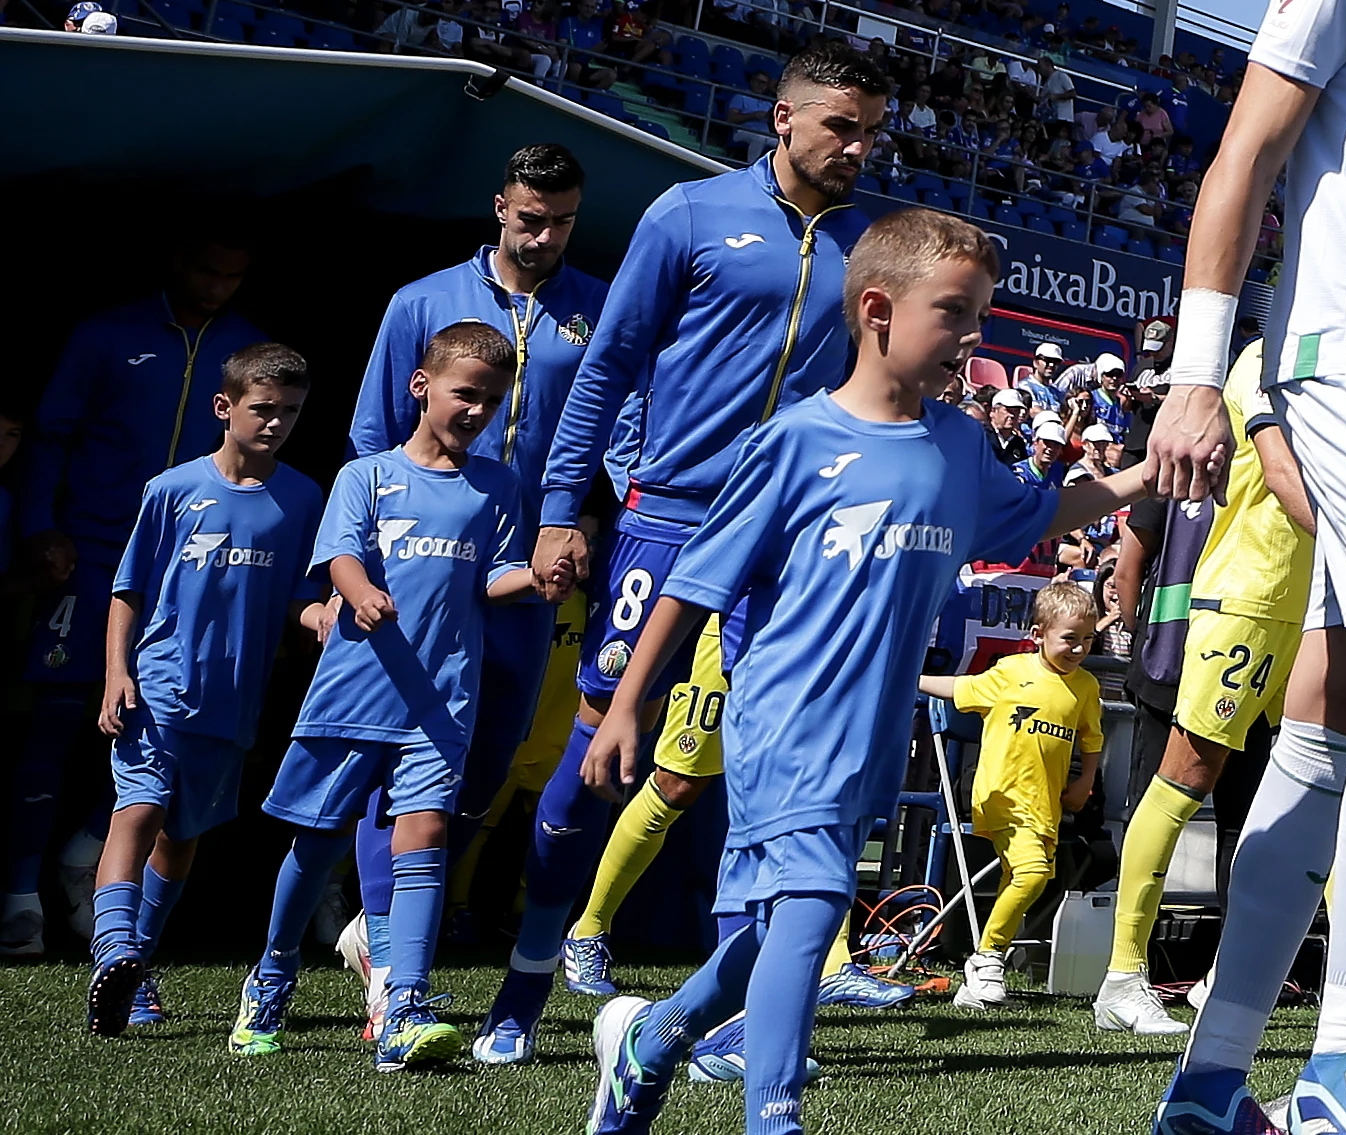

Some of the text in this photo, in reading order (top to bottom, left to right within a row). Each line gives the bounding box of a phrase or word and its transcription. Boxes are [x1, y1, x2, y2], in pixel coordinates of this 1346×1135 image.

[397, 535, 478, 563] Joma
[874, 523, 954, 560] Joma
[48, 595, 77, 638] 4
[612, 568, 654, 631] 8
[1221, 644, 1275, 699] 24
[685, 684, 726, 733] 10
[1027, 718, 1075, 743] Joma
